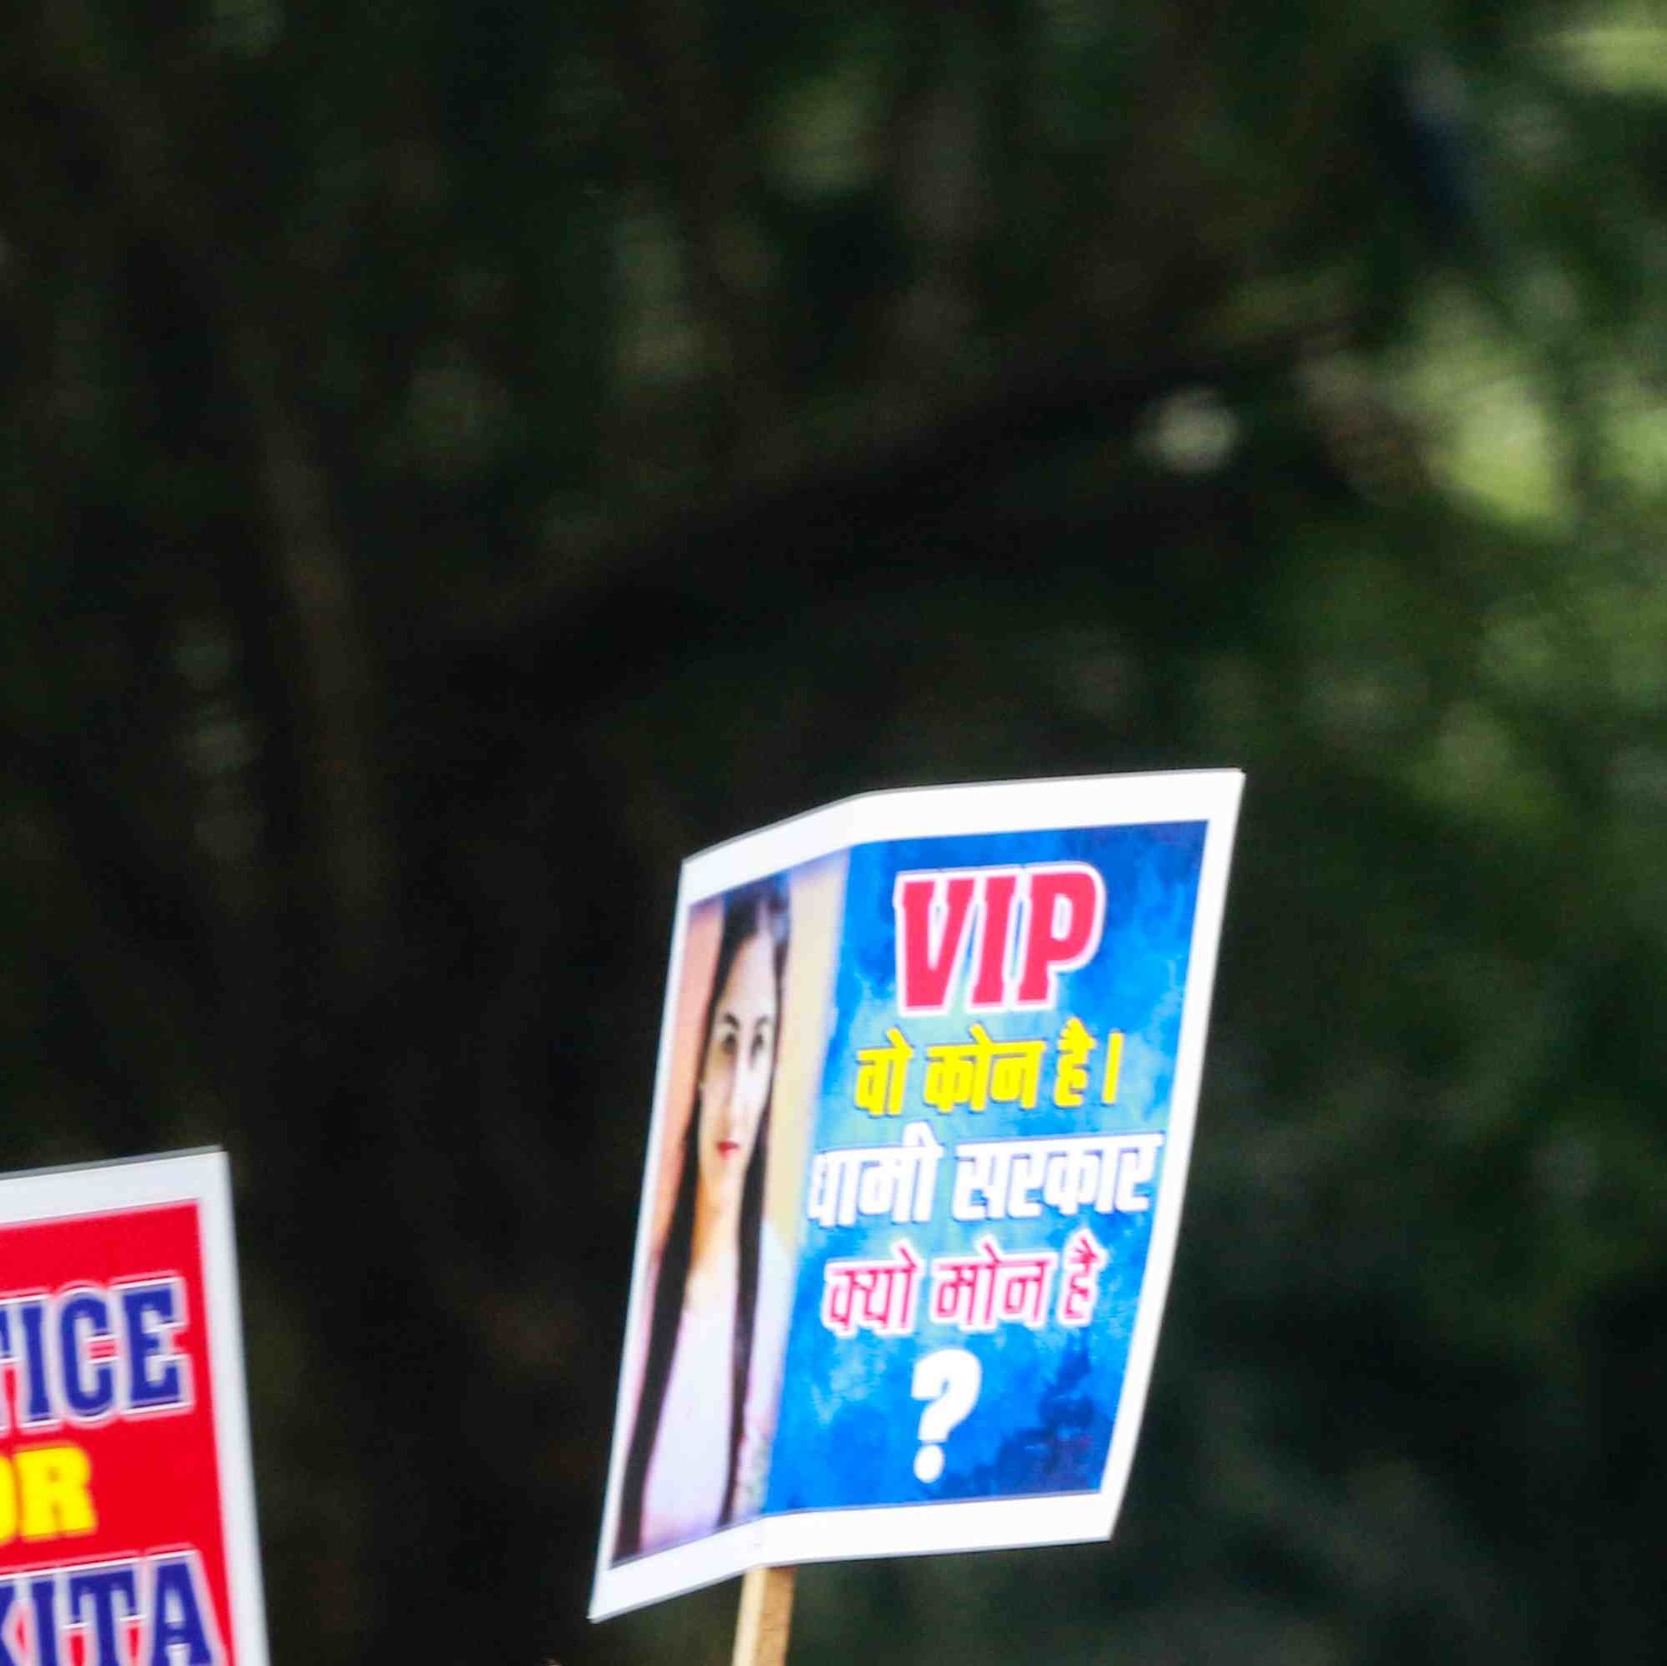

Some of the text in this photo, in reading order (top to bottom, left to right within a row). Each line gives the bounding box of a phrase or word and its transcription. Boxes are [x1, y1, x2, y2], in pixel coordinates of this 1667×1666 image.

[894, 862, 1107, 1017] VIP
[855, 1027, 913, 1116] वो
[924, 1023, 1047, 1113] कोन
[807, 1121, 1165, 1228] धामी सरकार
[822, 1229, 1108, 1338] क्यो मोन है
[911, 1350, 982, 1483] ?
